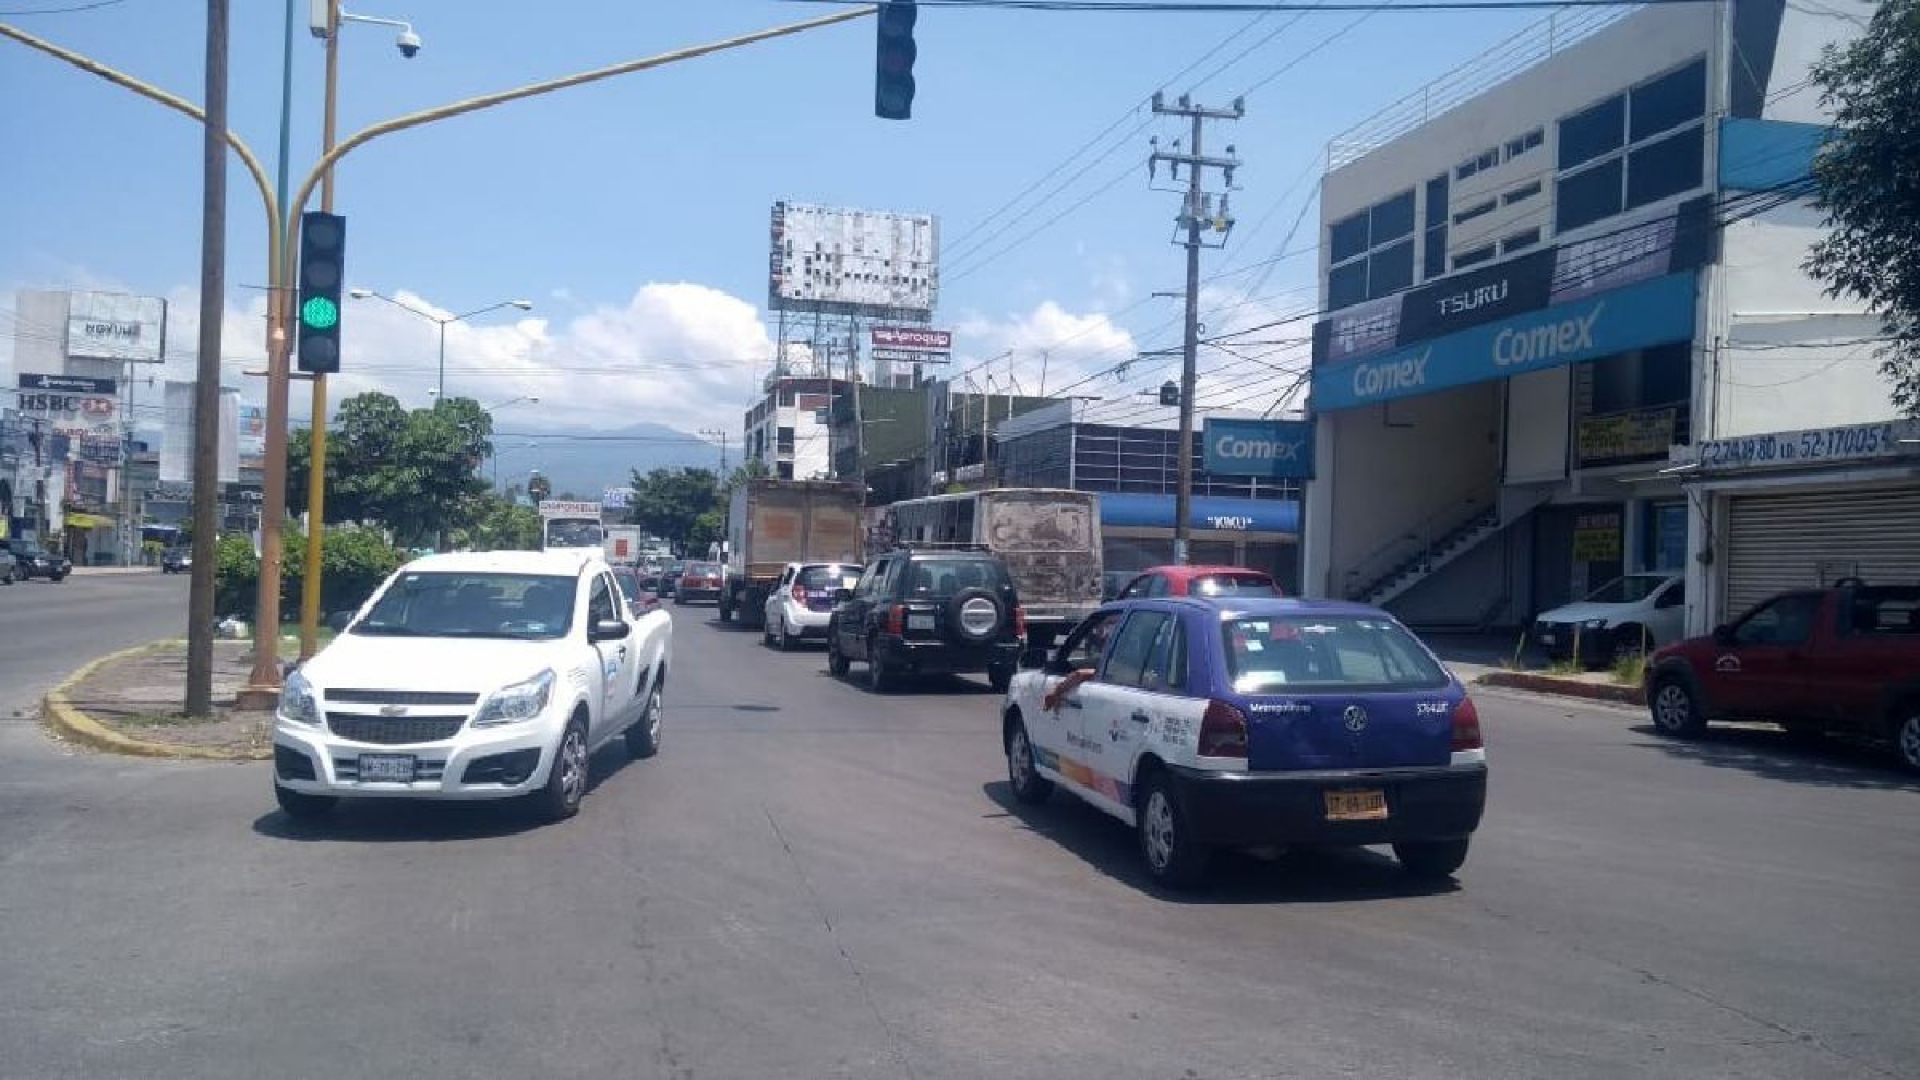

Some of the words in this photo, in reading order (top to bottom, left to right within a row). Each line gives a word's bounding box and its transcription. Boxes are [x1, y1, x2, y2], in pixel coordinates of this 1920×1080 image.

[1436, 279, 1509, 317] TSURU
[1492, 302, 1606, 367] Comex
[1354, 345, 1432, 396] Comex
[19, 393, 79, 412] HSBC
[1215, 435, 1306, 460] Comex
